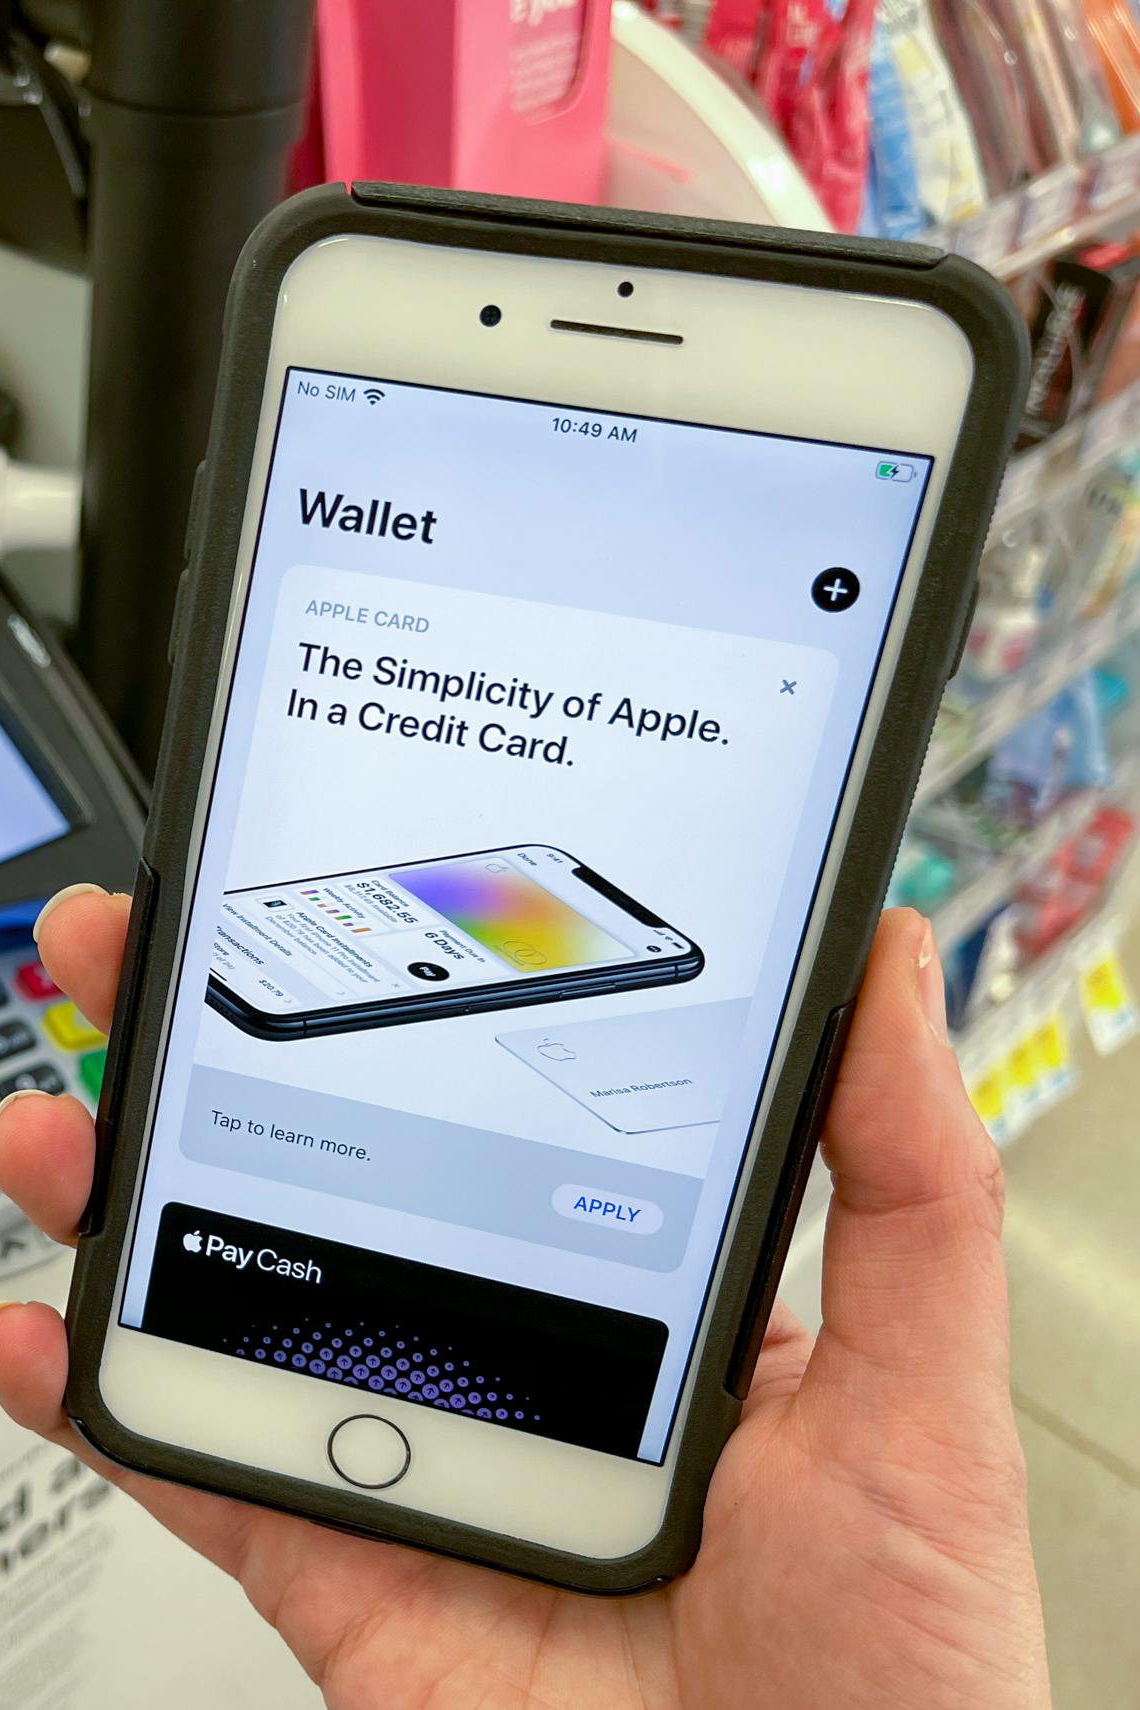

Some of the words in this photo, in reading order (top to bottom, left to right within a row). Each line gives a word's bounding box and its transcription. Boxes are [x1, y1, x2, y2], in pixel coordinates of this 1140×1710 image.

[297, 381, 320, 398] No
[325, 385, 356, 403] SIM
[551, 417, 603, 439] 10:49
[607, 424, 638, 444] AM
[298, 488, 438, 546] Wallet
[305, 599, 368, 624] APPLE
[374, 610, 430, 634] CARD
[298, 641, 363, 680] The
[372, 655, 555, 720] Simplicity
[562, 692, 603, 721] of
[608, 697, 730, 746] Apple.
[286, 689, 319, 720] In
[327, 704, 349, 726] a
[358, 701, 468, 747] Credit
[478, 723, 574, 767] Card.
[356, 882, 419, 924] $1,682.55
[433, 939, 465, 960] Days
[589, 1086, 631, 1098] Marisa
[629, 1078, 693, 1092] Robertson
[211, 1110, 242, 1131] Tap
[248, 1119, 265, 1136] to
[270, 1123, 315, 1149] learn
[320, 1137, 372, 1162] more.
[573, 1195, 642, 1225] APPLY
[206, 1234, 254, 1270] Pay
[257, 1248, 323, 1284] Cash
